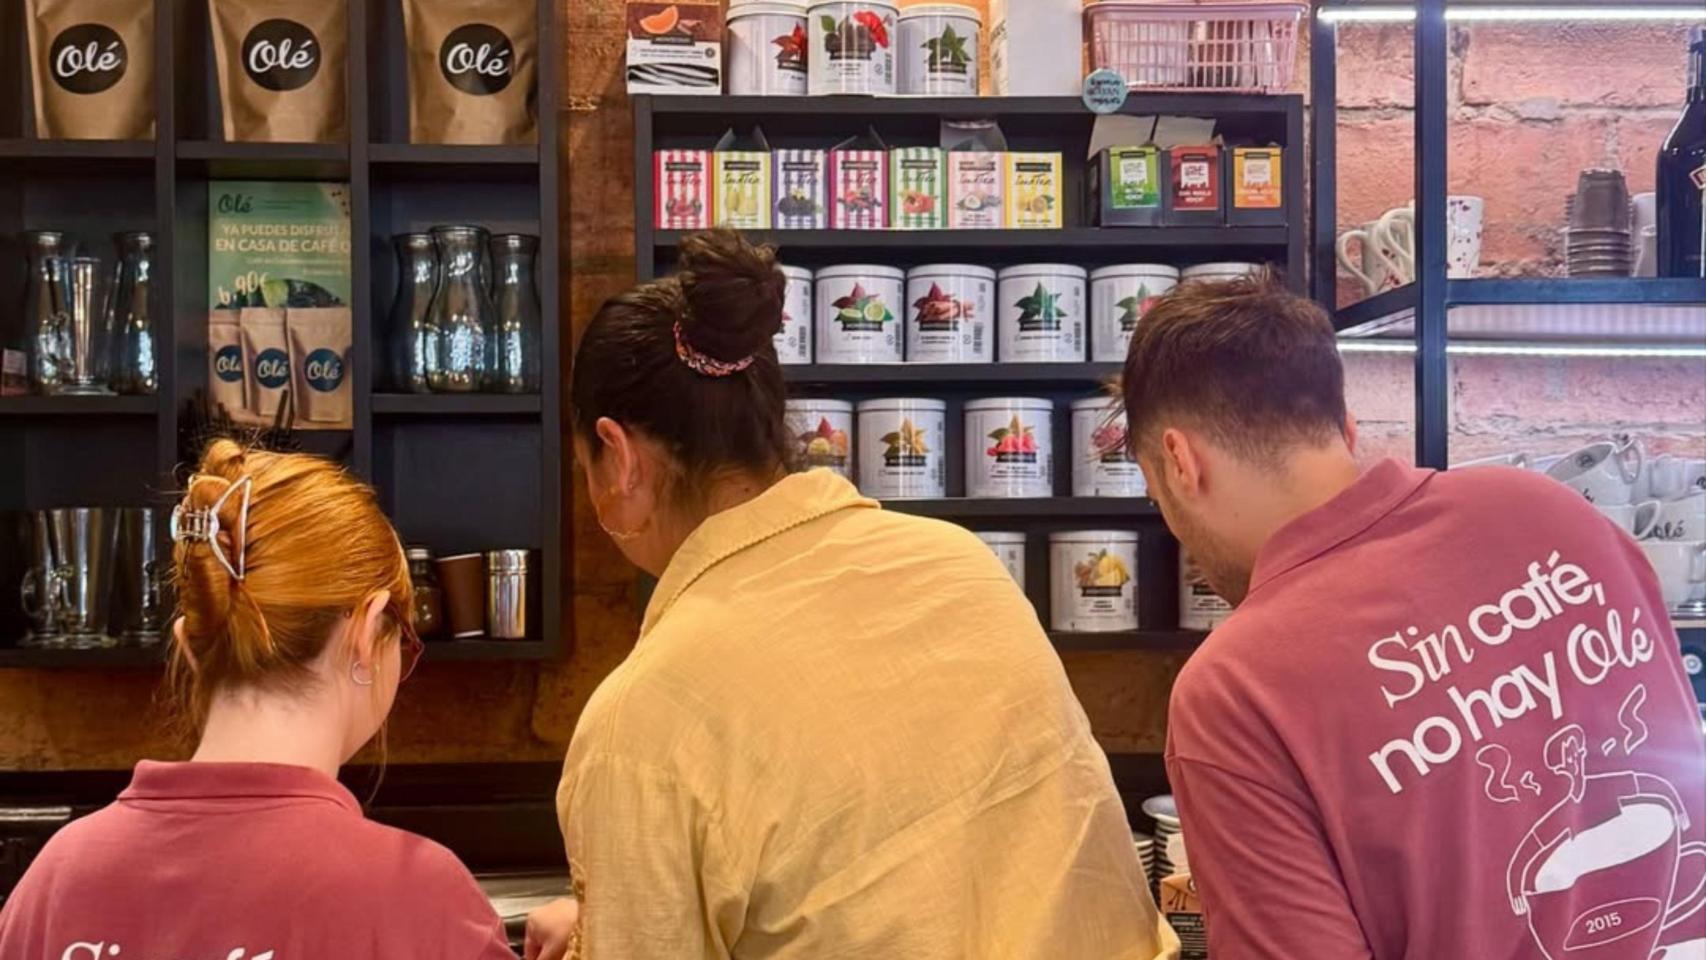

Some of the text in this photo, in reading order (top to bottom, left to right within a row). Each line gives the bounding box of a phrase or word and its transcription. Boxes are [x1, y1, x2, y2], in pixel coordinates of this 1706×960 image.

[55, 41, 121, 77] Olé
[249, 38, 315, 73] Olé
[446, 43, 509, 76] Olé
[218, 194, 254, 213] Olé
[222, 224, 239, 236] YA
[241, 224, 289, 236] PUEDES
[215, 239, 235, 252] EN
[238, 238, 276, 252] CASA
[279, 238, 299, 252] DE
[301, 237, 337, 253] CAFÉ
[257, 359, 289, 378] Olé
[307, 361, 342, 380] Olé
[1367, 550, 1606, 708] Sin café,
[1369, 608, 1655, 794] no hay Olé
[1585, 912, 1622, 934] 2015
